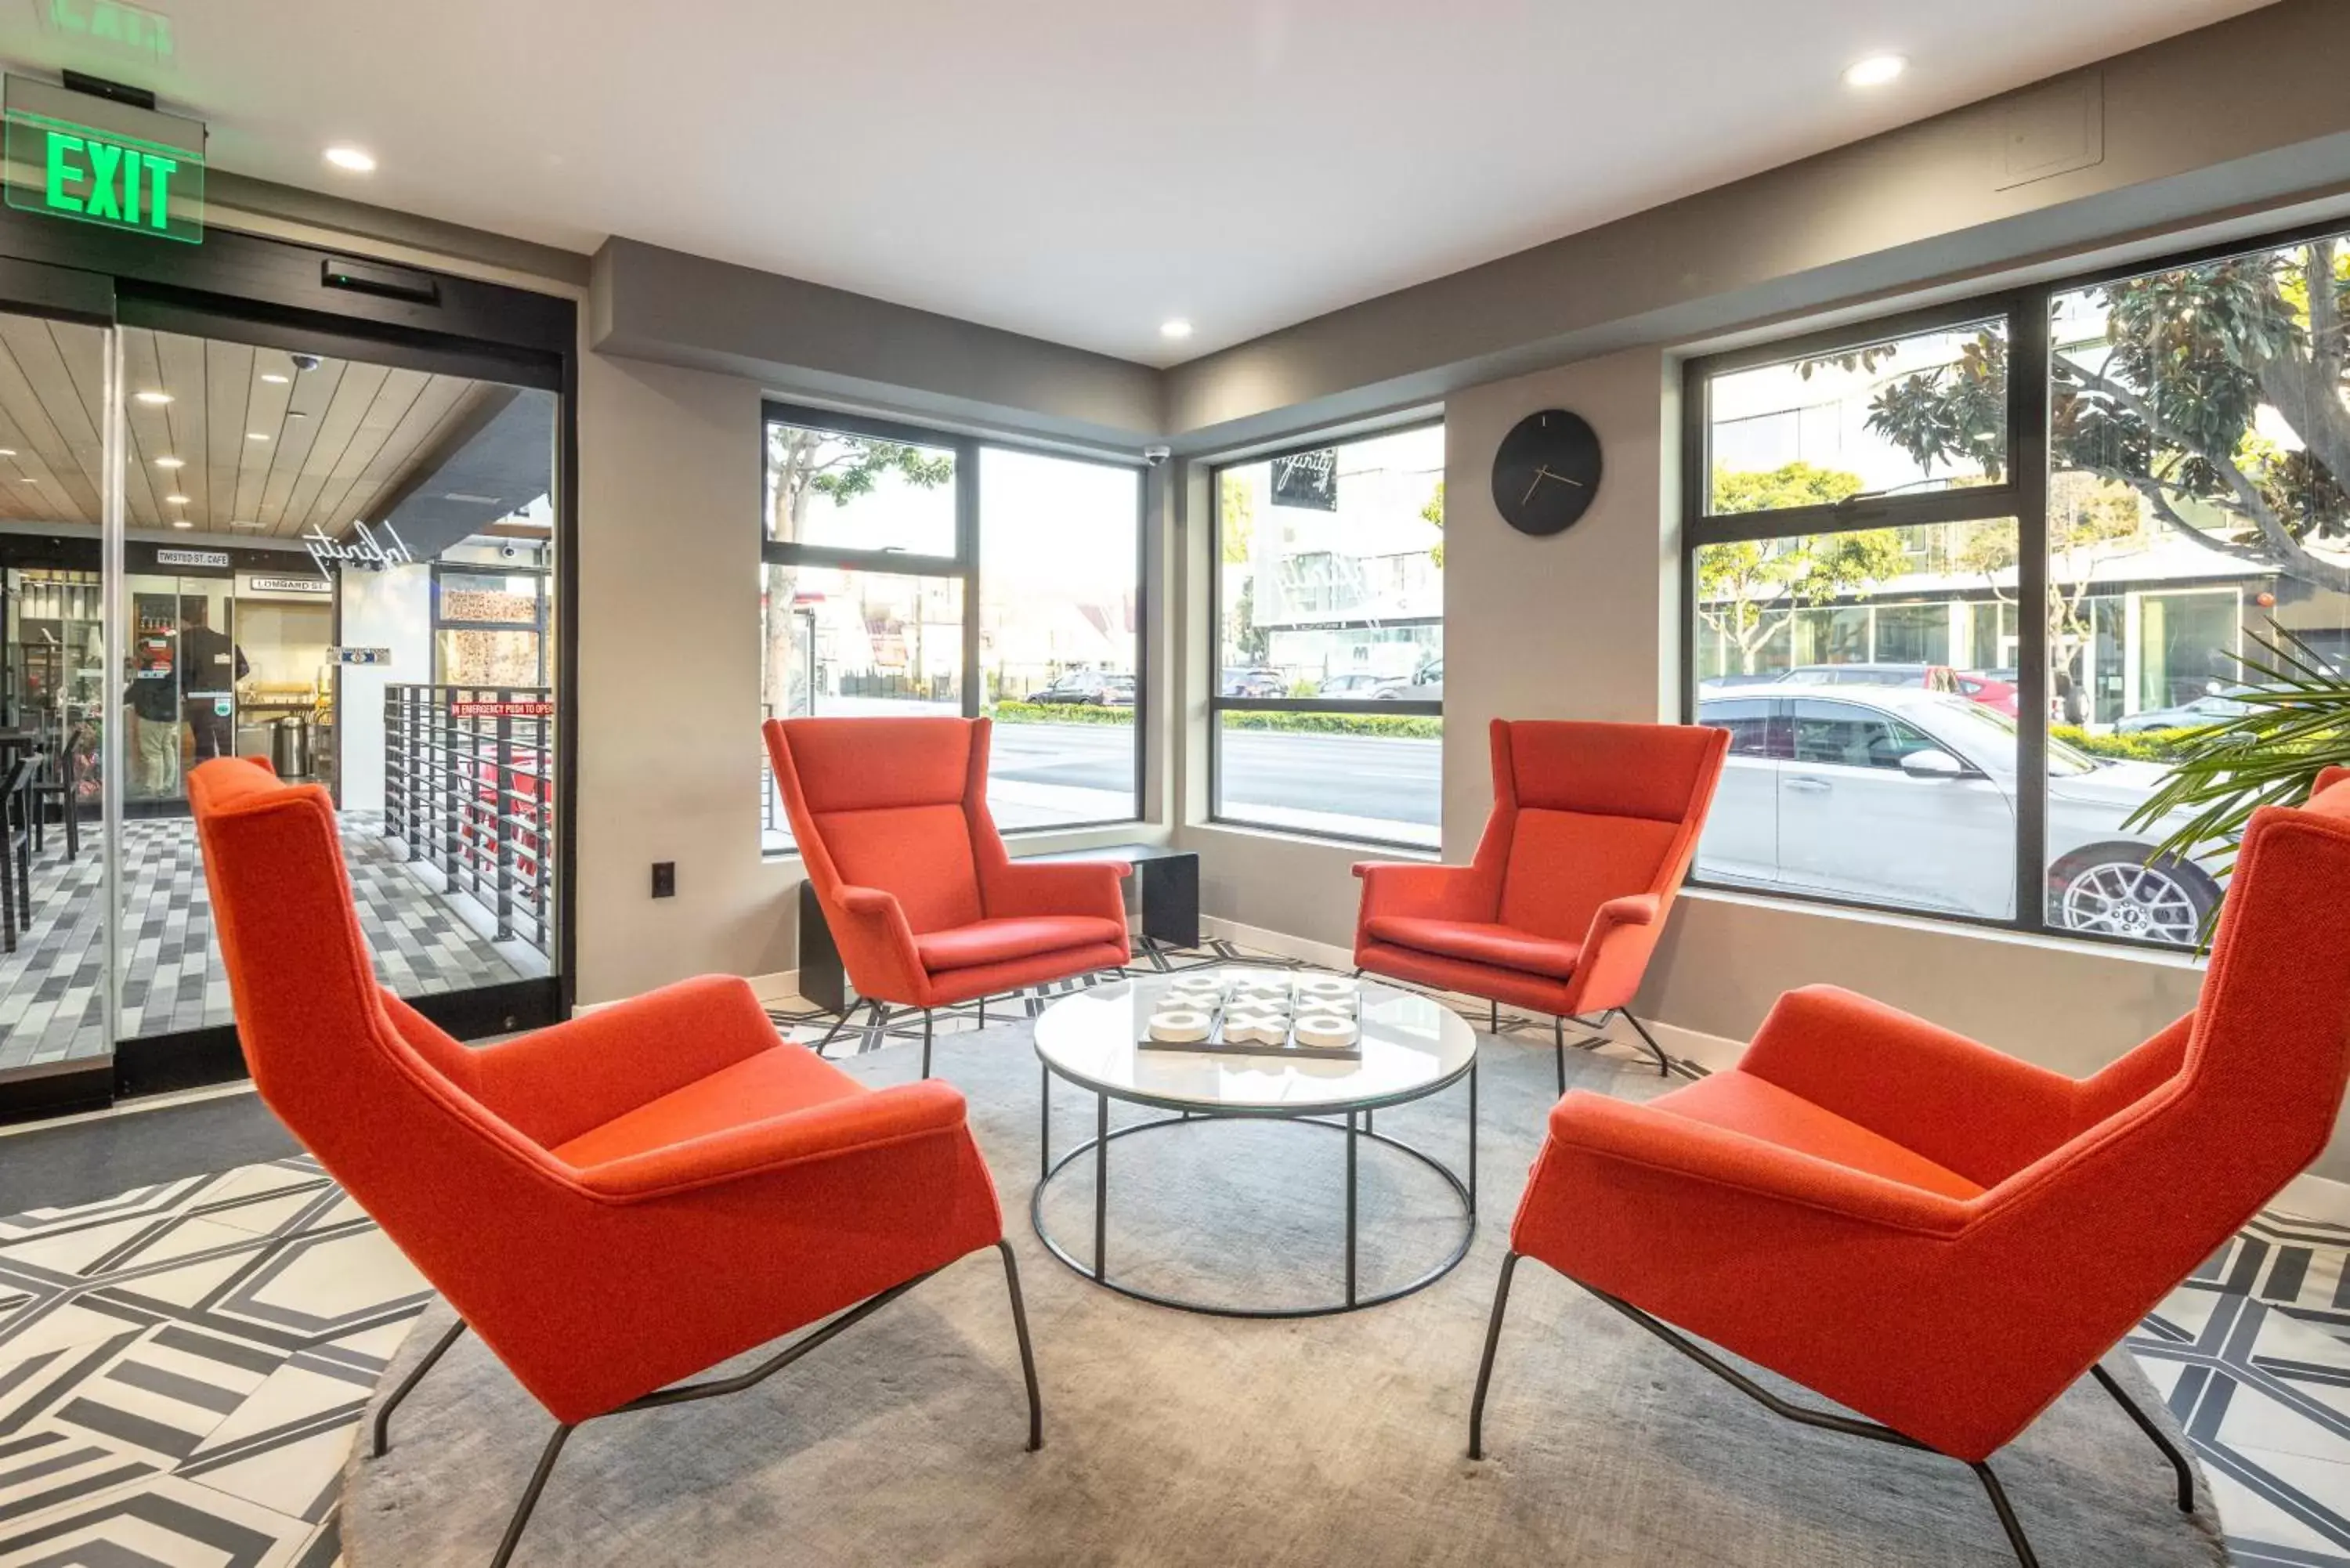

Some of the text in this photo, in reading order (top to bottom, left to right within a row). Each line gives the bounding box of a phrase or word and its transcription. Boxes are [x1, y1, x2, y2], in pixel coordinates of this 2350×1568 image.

[46, 131, 177, 229] EXIT
[452, 704, 460, 714] IN
[461, 704, 504, 714] EMERGENCY
[505, 704, 523, 714] PUSH
[526, 705, 535, 714] TO
